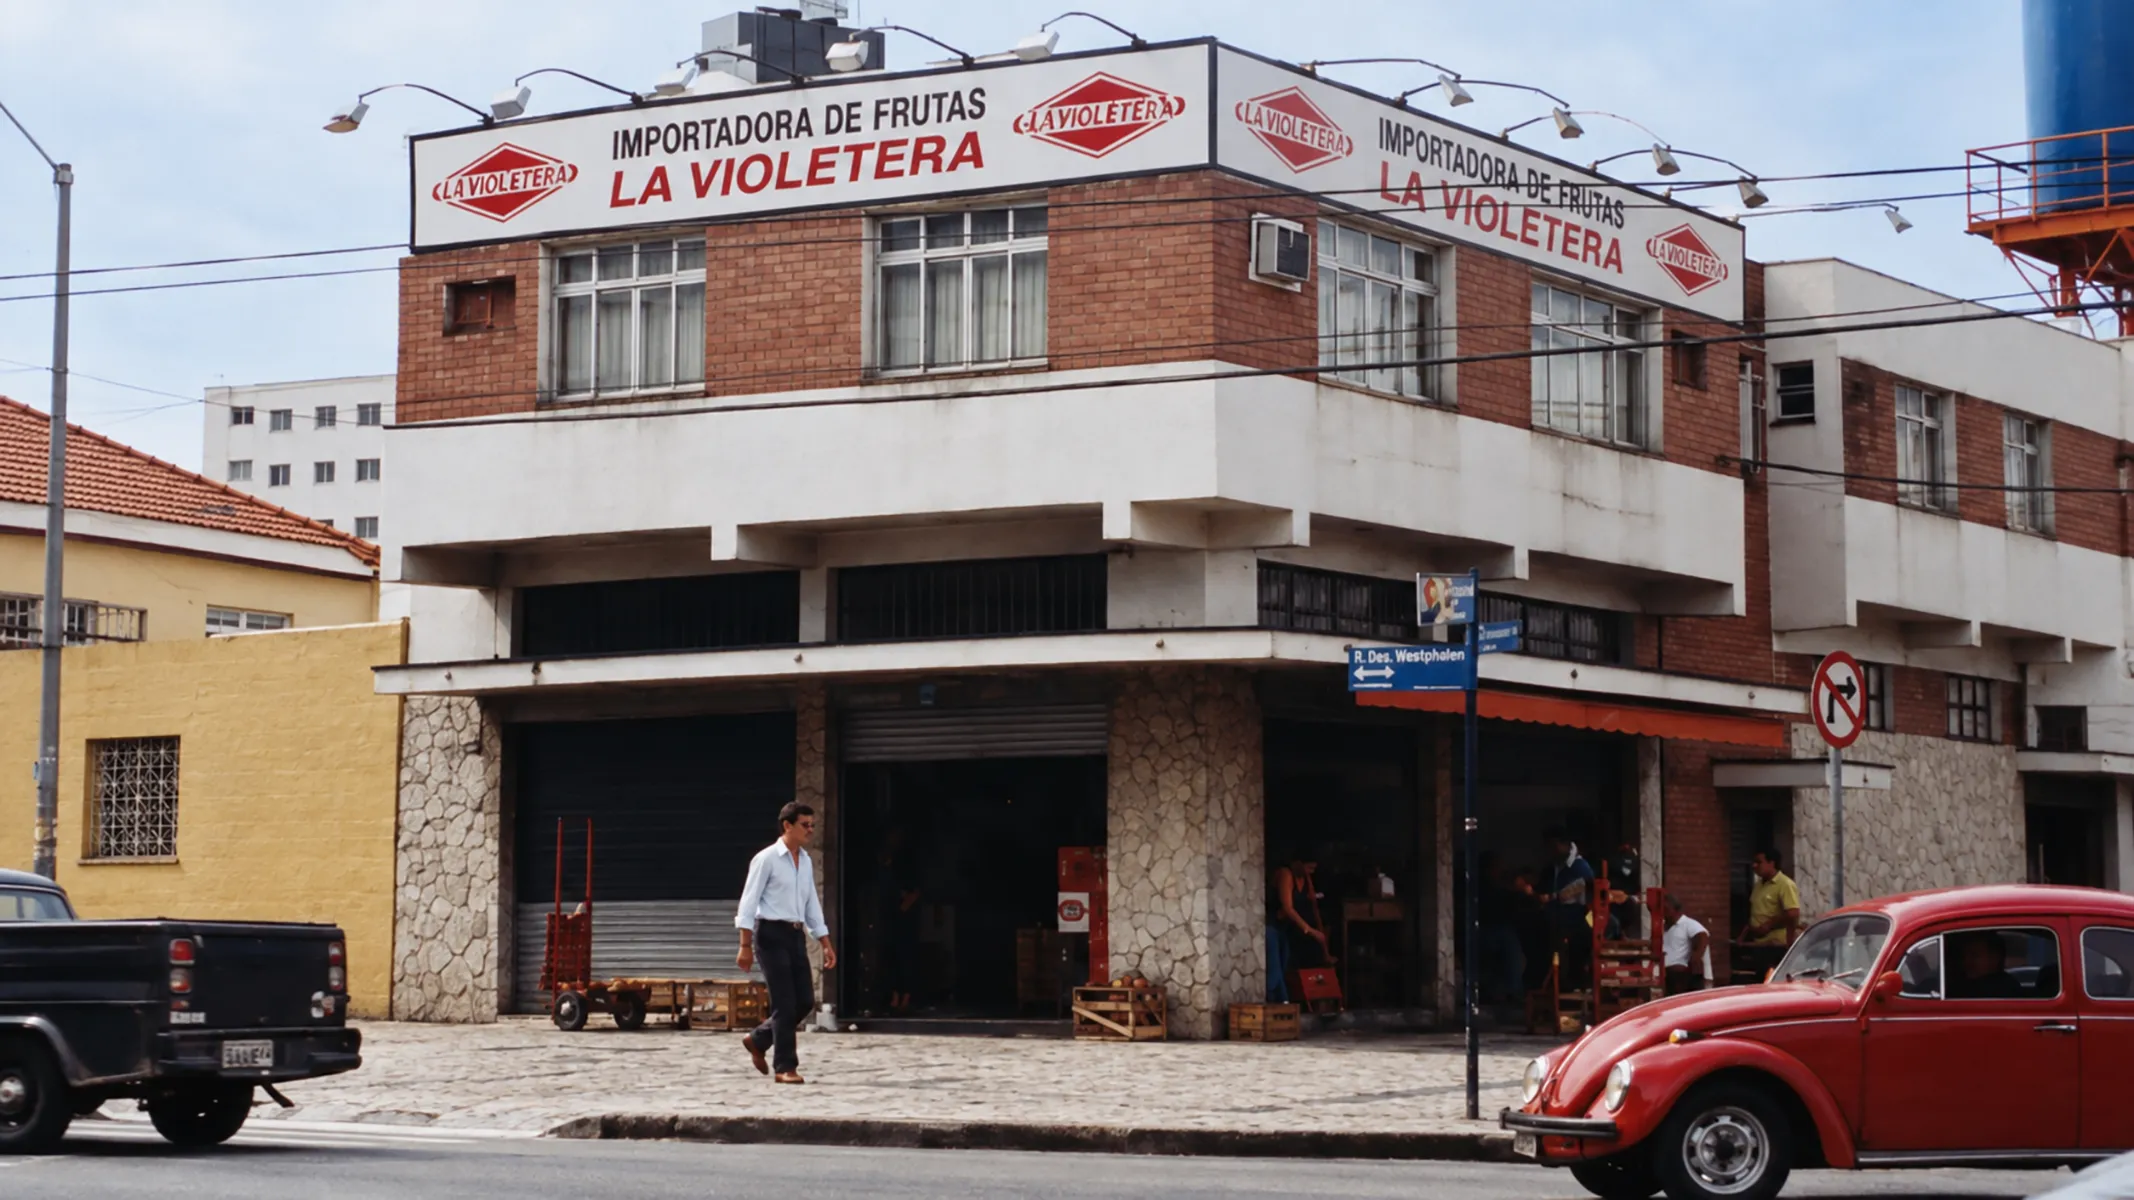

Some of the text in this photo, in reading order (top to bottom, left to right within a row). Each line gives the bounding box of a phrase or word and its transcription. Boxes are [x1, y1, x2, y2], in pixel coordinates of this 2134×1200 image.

[612, 87, 986, 160] IMPORTADORA DE FRUTAS
[1058, 95, 1174, 128] VIOLETERA
[1244, 102, 1345, 155] LA VIOLETERA
[443, 165, 567, 200] LA VIOLETERA
[610, 131, 984, 208] LA VIOLETERA
[1379, 117, 1624, 229] IMPORTADORA DE FRUTAS
[1380, 160, 1623, 274] LA VIOLETERA
[1667, 242, 1723, 278] VIOLETERA
[1354, 650, 1367, 663] R.
[1368, 650, 1393, 663] Des.
